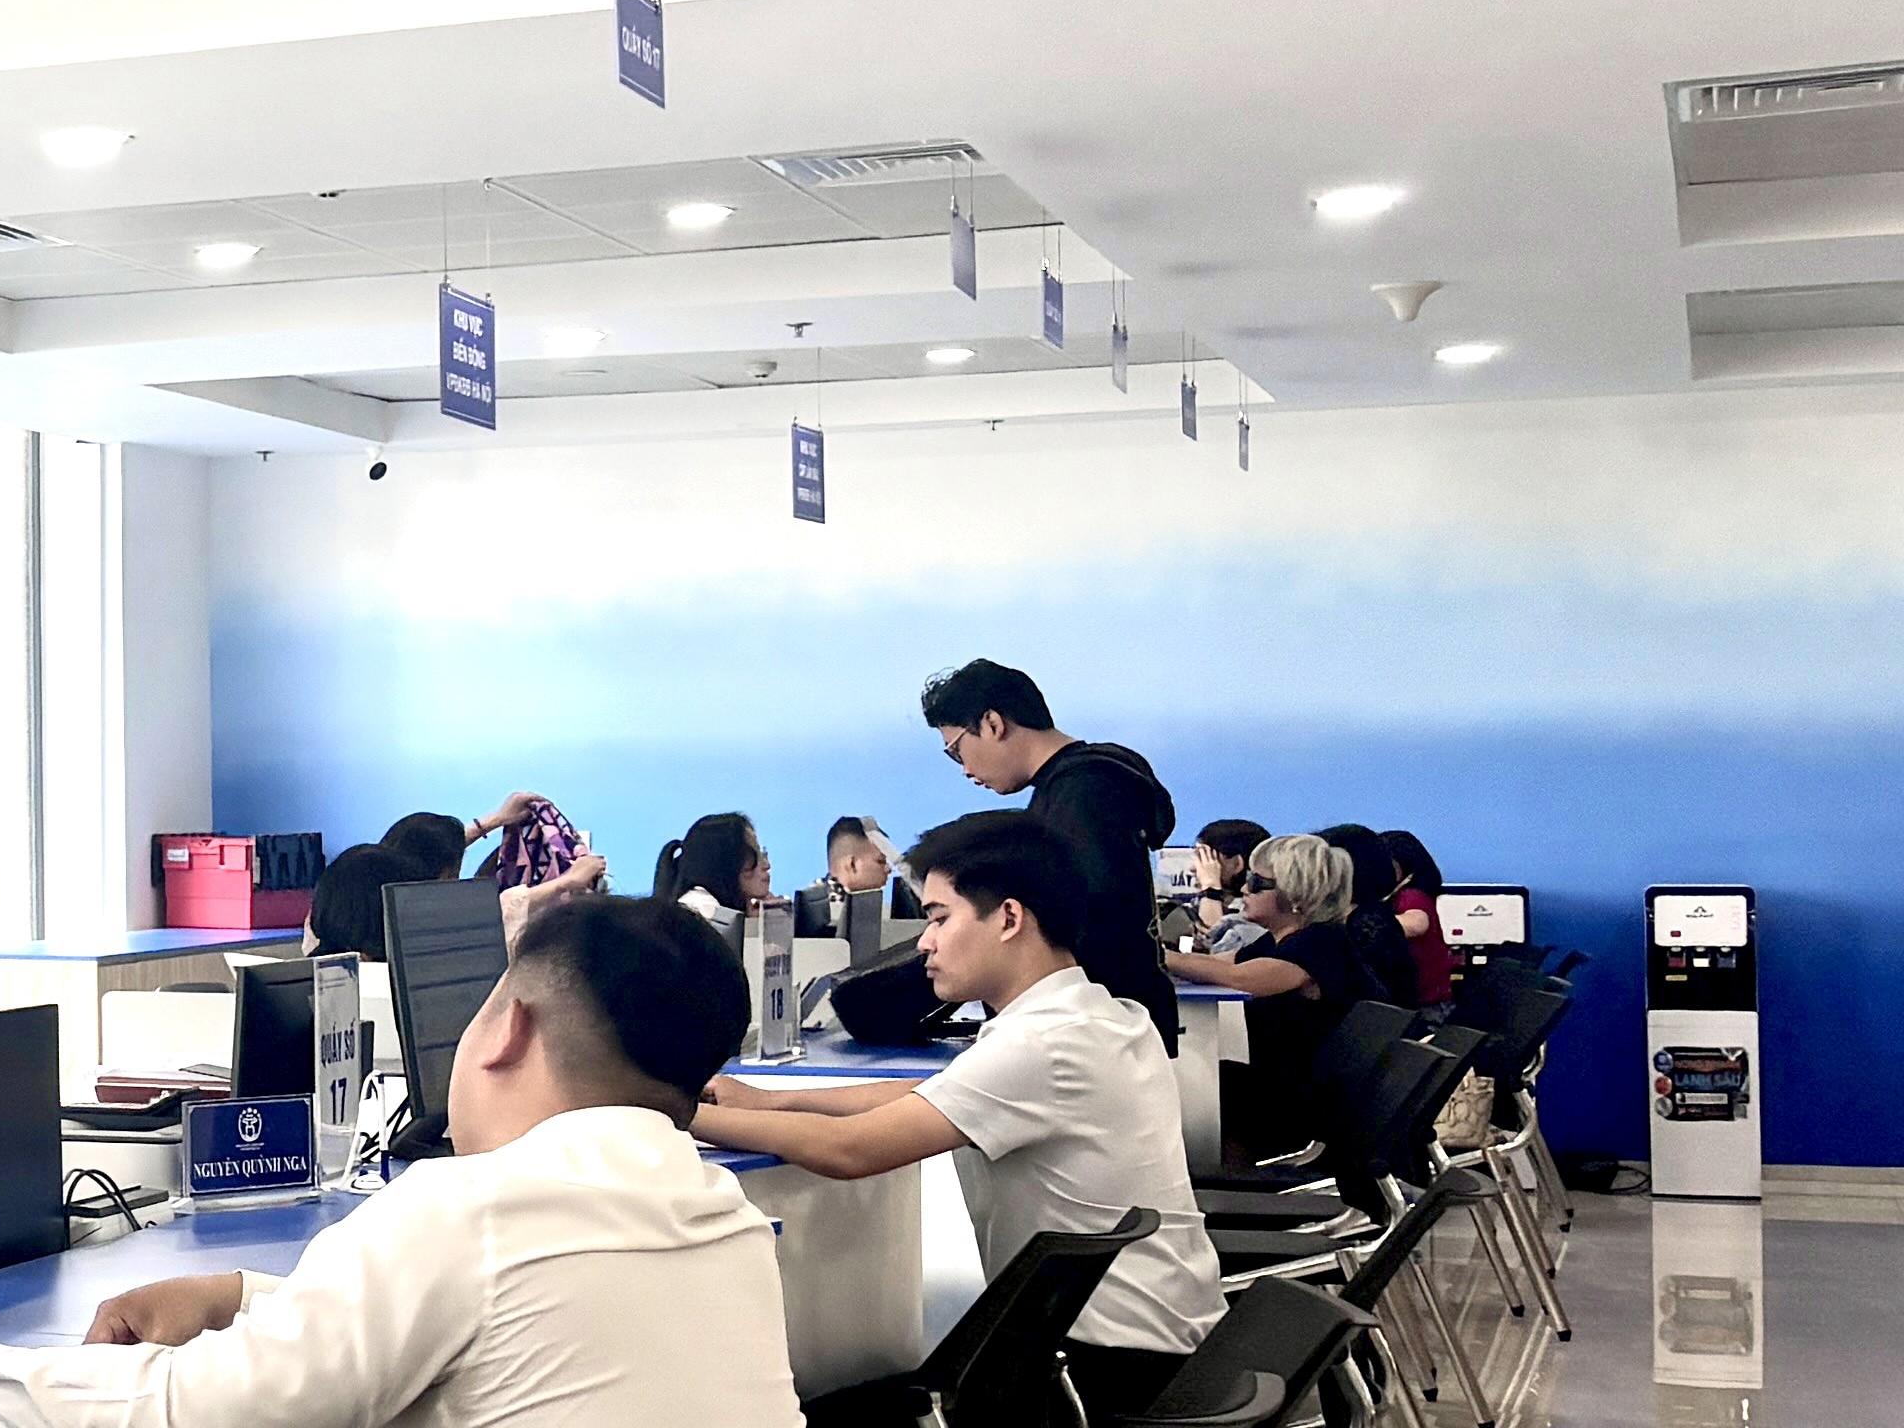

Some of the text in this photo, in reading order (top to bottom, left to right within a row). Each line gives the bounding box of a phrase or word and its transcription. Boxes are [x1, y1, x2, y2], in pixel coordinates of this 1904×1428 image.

[771, 987, 784, 1021] 18
[330, 1078, 347, 1125] 17
[283, 1156, 307, 1172] NGA
